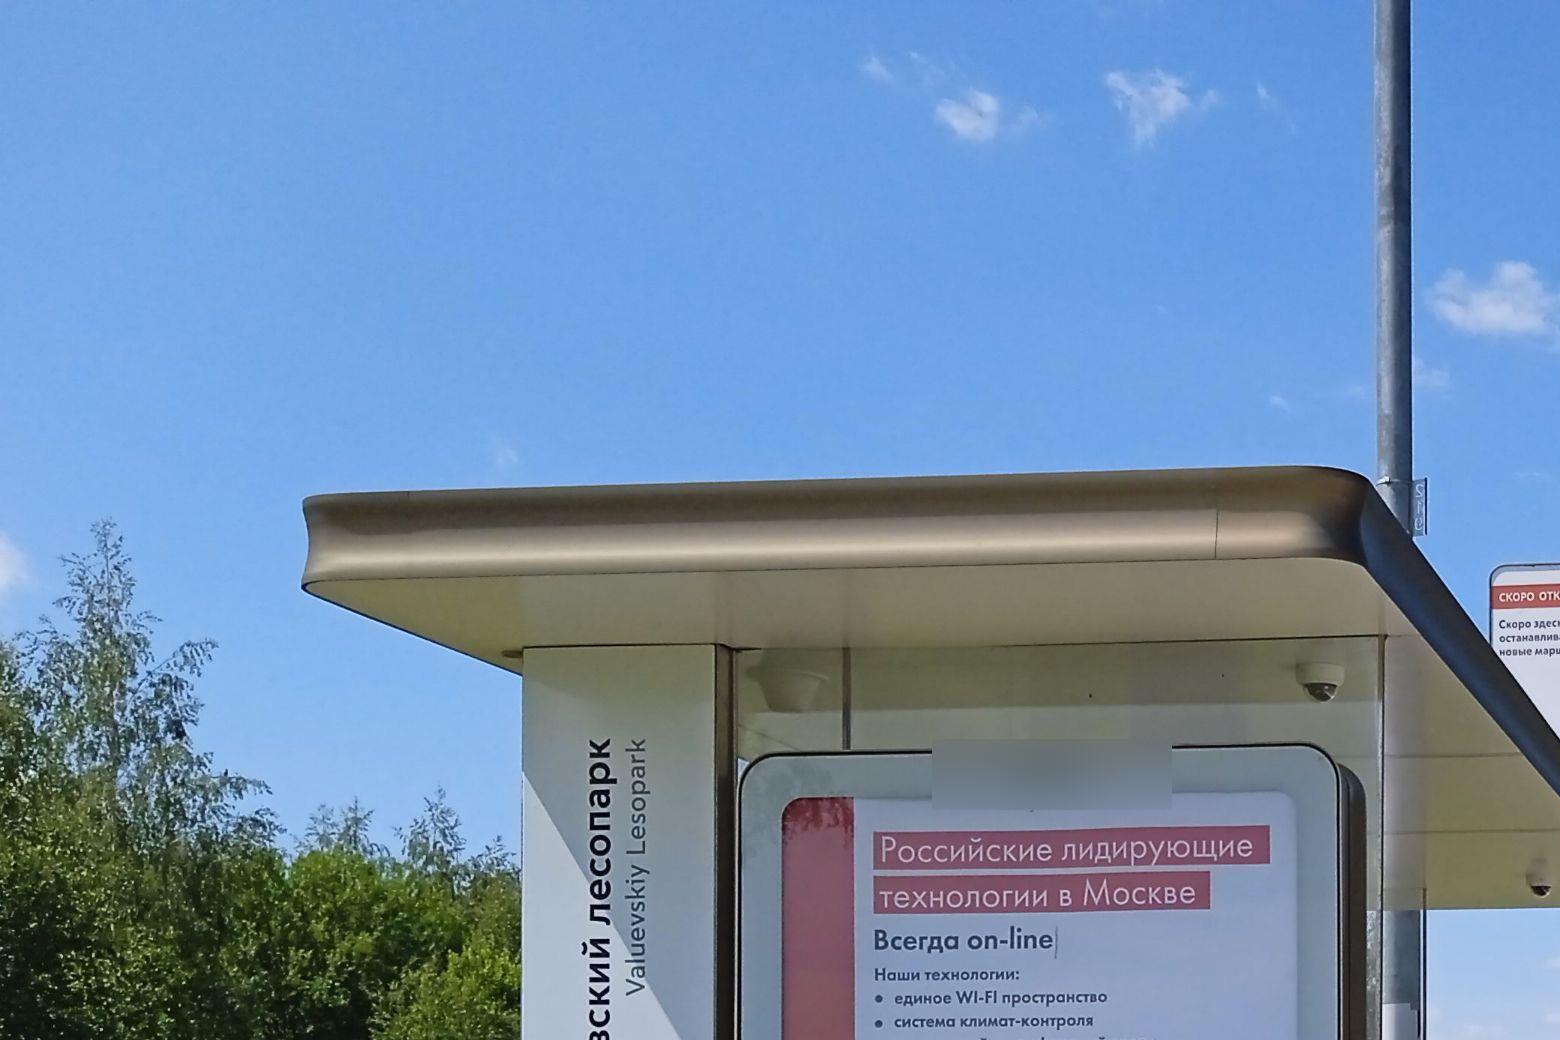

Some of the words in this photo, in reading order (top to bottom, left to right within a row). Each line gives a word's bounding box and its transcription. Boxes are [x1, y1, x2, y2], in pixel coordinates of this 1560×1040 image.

[1498, 591, 1535, 602] СКОРО
[1498, 619, 1532, 630] Скоро
[1499, 648, 1532, 657] новые
[625, 737, 651, 855] Lesopark
[589, 737, 618, 926] лесопарк
[881, 835, 1052, 863] Российские
[1061, 838, 1253, 866] лидирующие
[879, 889, 1048, 909] технологии
[1059, 889, 1073, 907] в
[1083, 878, 1196, 906] Москве
[625, 863, 651, 997] Valuevskiy
[874, 929, 960, 954] Всегда
[967, 925, 1053, 950] on-line
[874, 968, 921, 981] Наши
[924, 970, 1020, 981] технологии:
[894, 994, 952, 1006] единое
[956, 990, 998, 1004] WI-FI
[1002, 992, 1108, 1007] пространство
[894, 1017, 956, 1028] система
[960, 1016, 1094, 1030] климат-контроля
